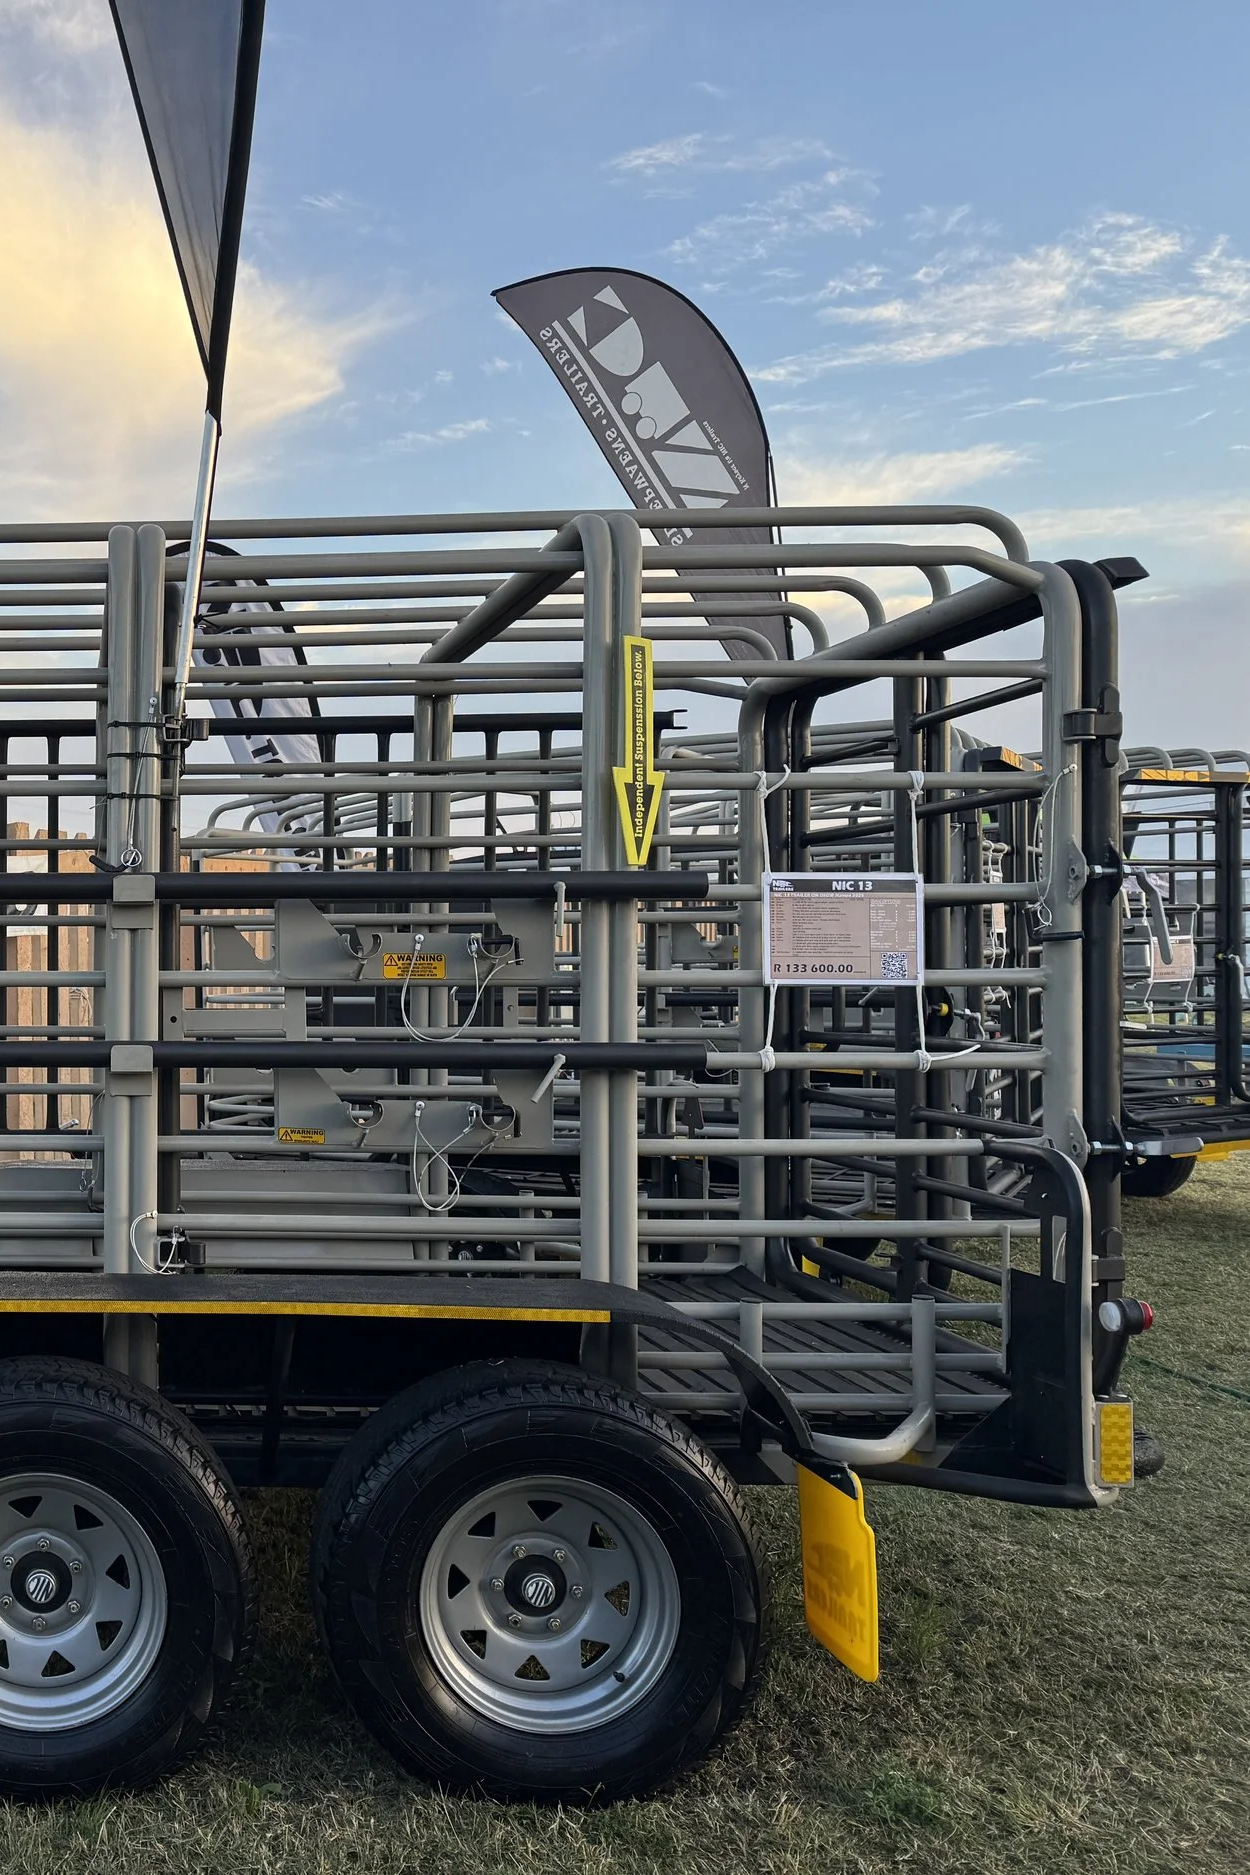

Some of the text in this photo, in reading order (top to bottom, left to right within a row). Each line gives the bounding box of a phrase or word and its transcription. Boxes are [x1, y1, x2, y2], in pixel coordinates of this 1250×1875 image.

[634, 650, 645, 838] Independent Suspenssion Below.
[832, 881, 873, 891] NIC 13
[773, 963, 853, 973] R 133 600.00
